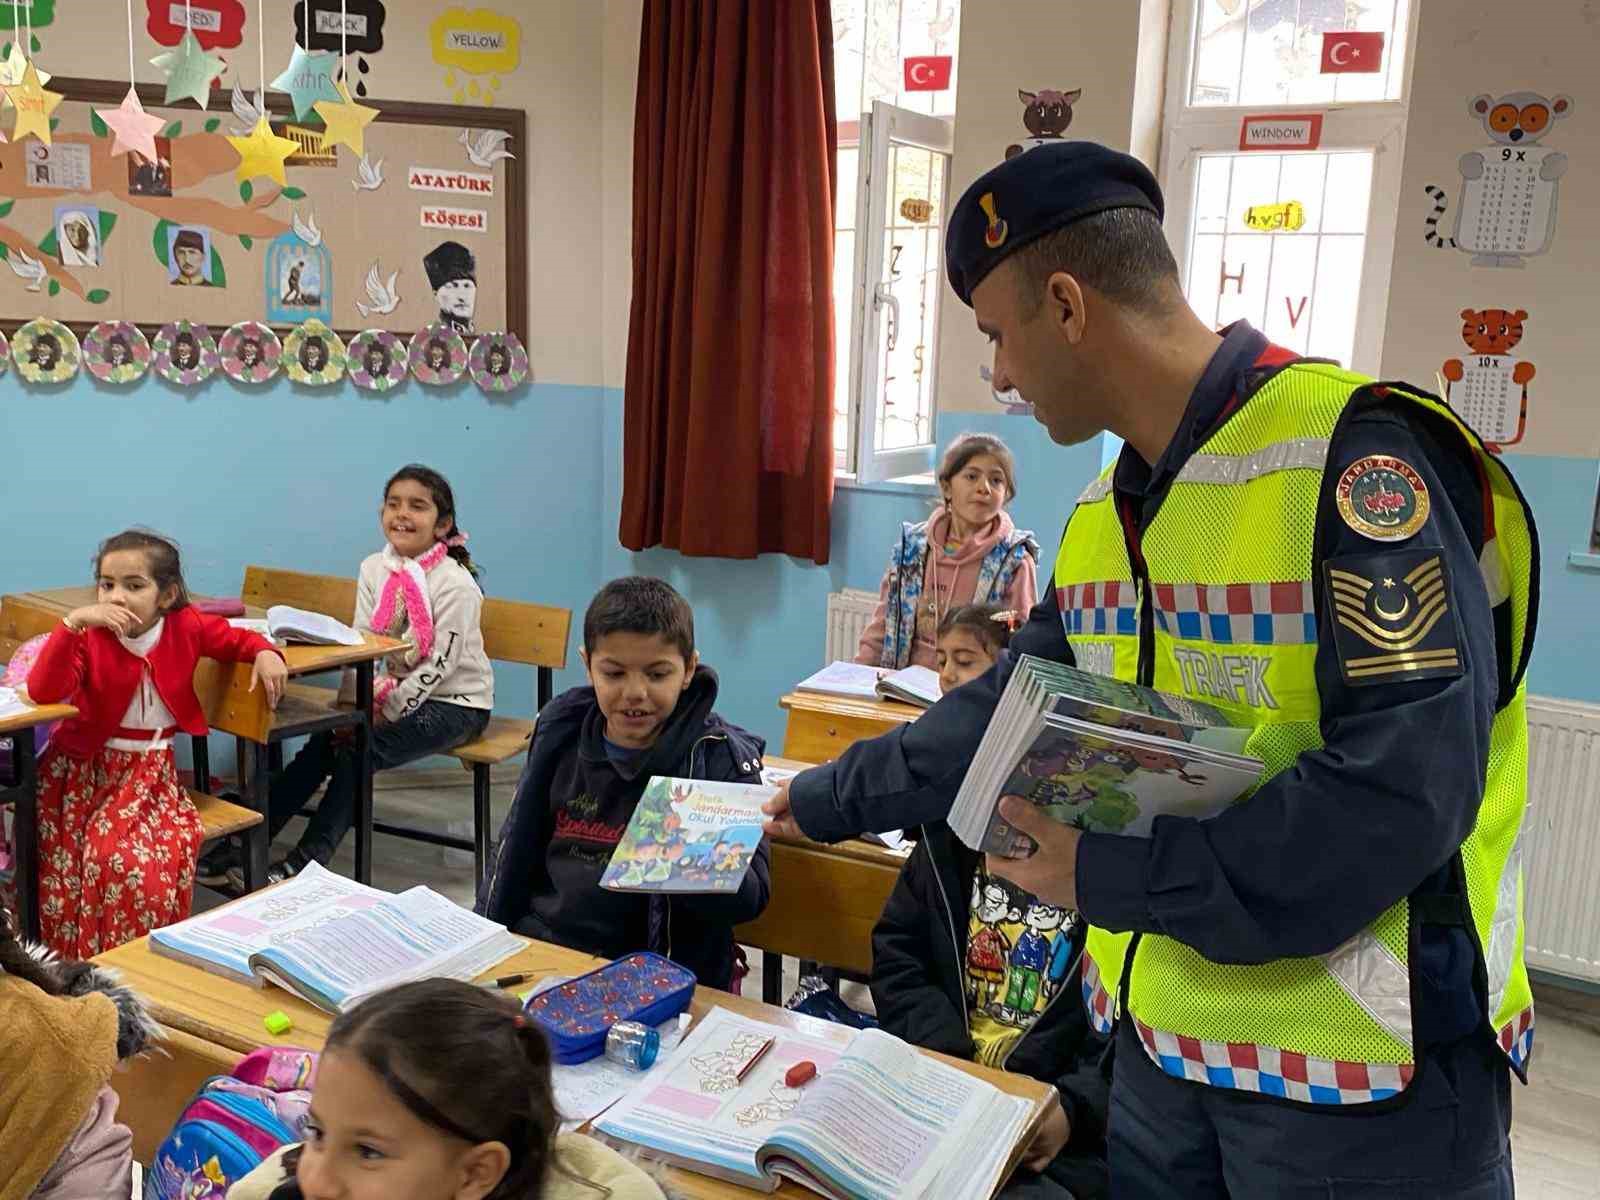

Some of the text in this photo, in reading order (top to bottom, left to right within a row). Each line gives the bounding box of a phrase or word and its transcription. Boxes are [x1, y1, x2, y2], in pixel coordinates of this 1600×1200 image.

[452, 32, 500, 48] YELLOW
[1249, 127, 1304, 138] WINDOW
[1501, 148, 1526, 161] 9 x
[410, 172, 492, 192] ATATÜRK
[424, 209, 484, 229] KÖŞESİ
[1285, 296, 1307, 329] V
[1478, 357, 1490, 368] 10
